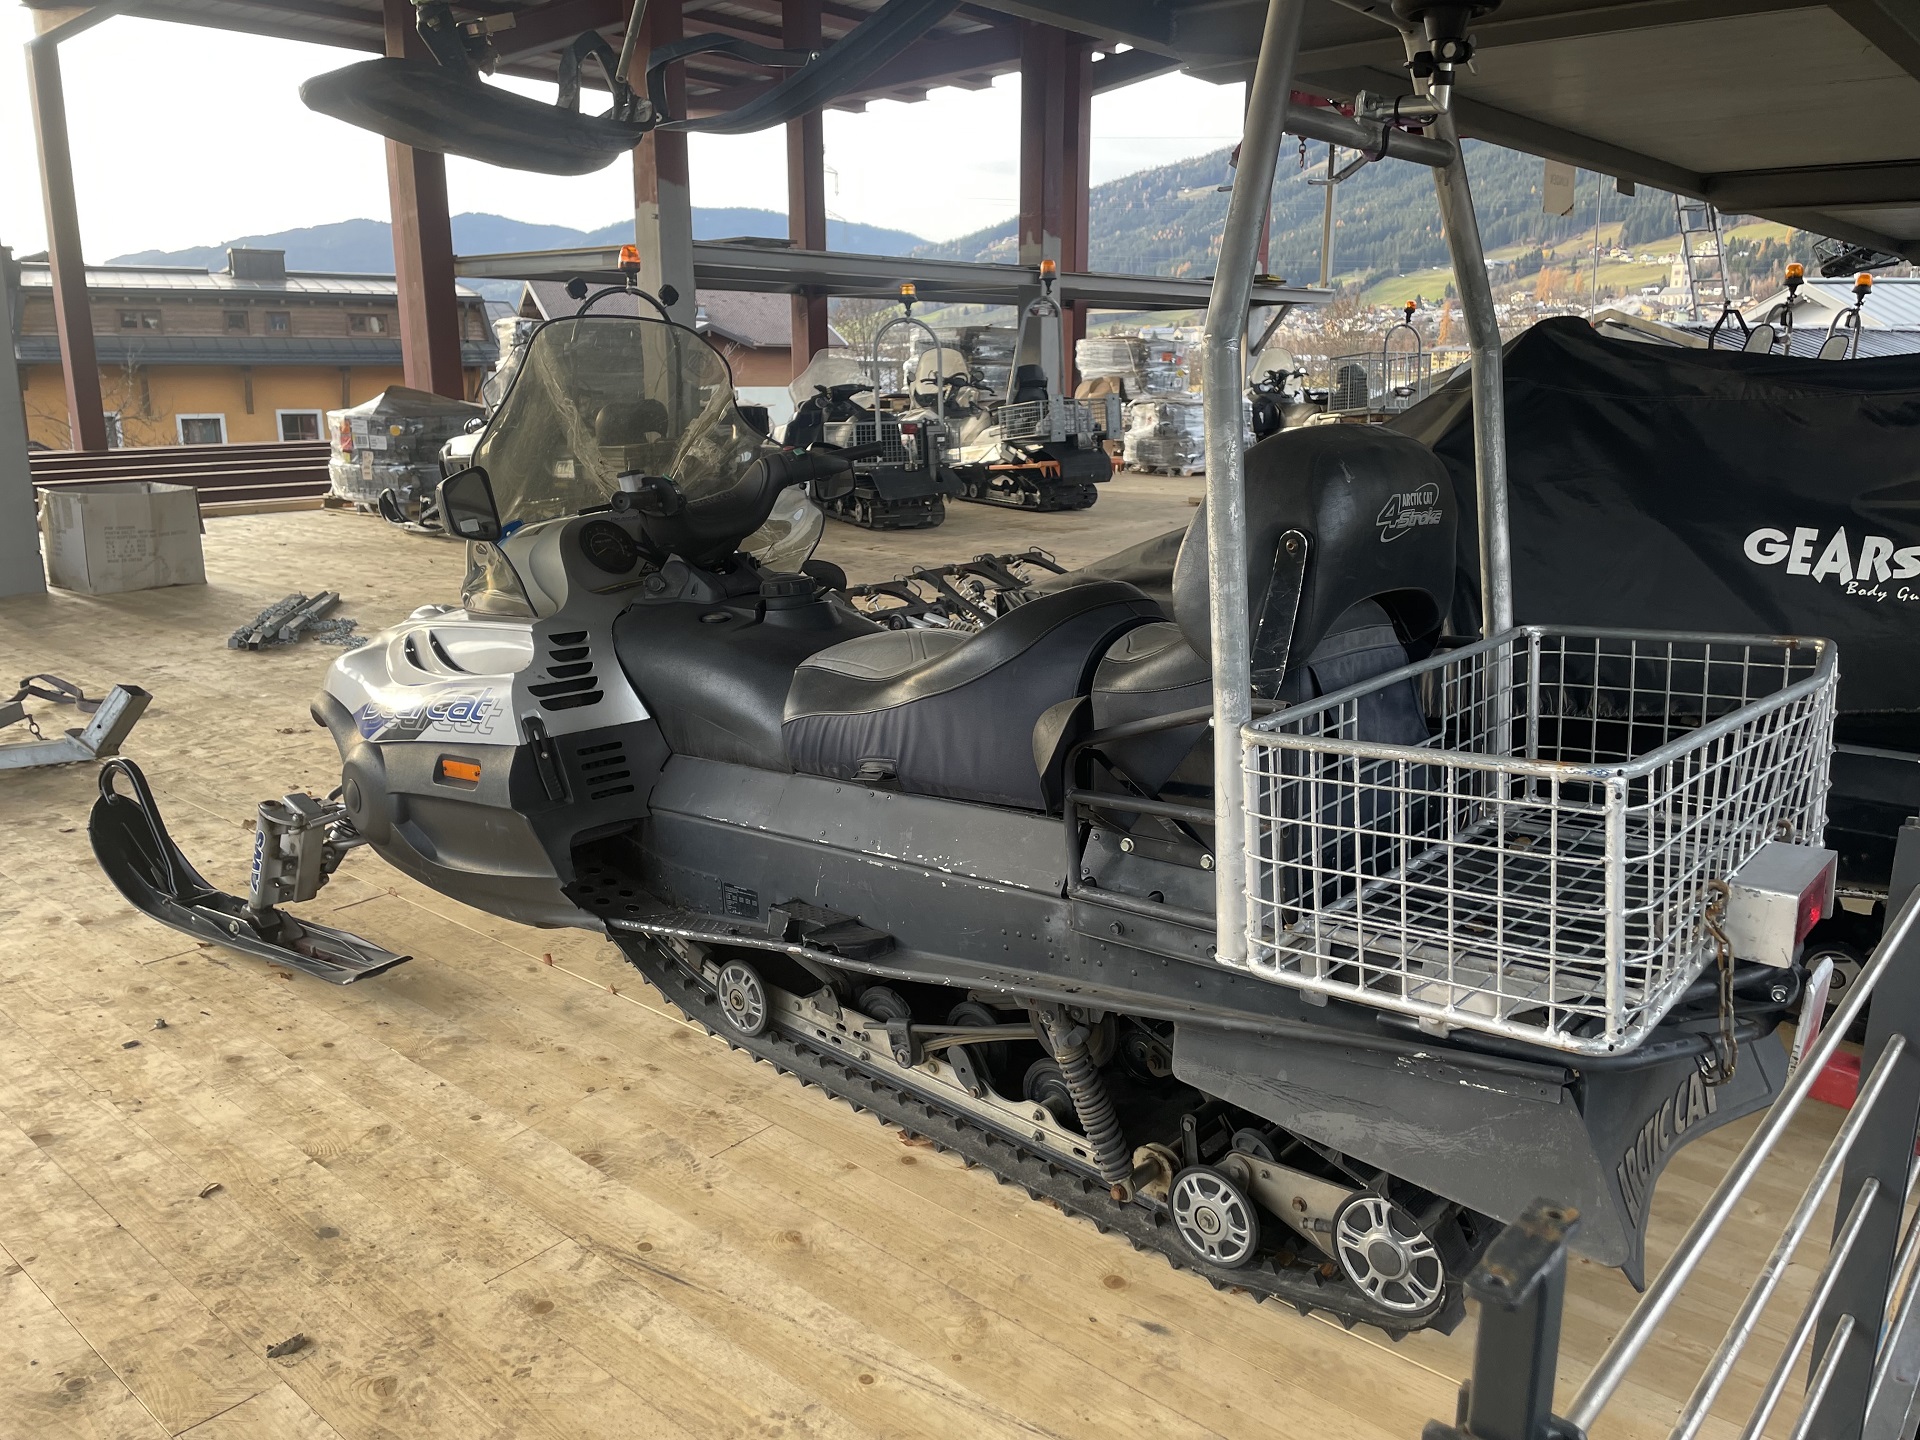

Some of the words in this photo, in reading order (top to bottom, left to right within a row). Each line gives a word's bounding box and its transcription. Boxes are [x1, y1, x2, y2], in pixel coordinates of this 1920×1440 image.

[1402, 492, 1422, 507] ARCTIC
[1423, 491, 1433, 505] CAT
[1743, 526, 1920, 586] GEARS
[1846, 581, 1888, 602] Body
[250, 829, 266, 895] AWS
[1616, 1097, 1671, 1229] ARCTIC
